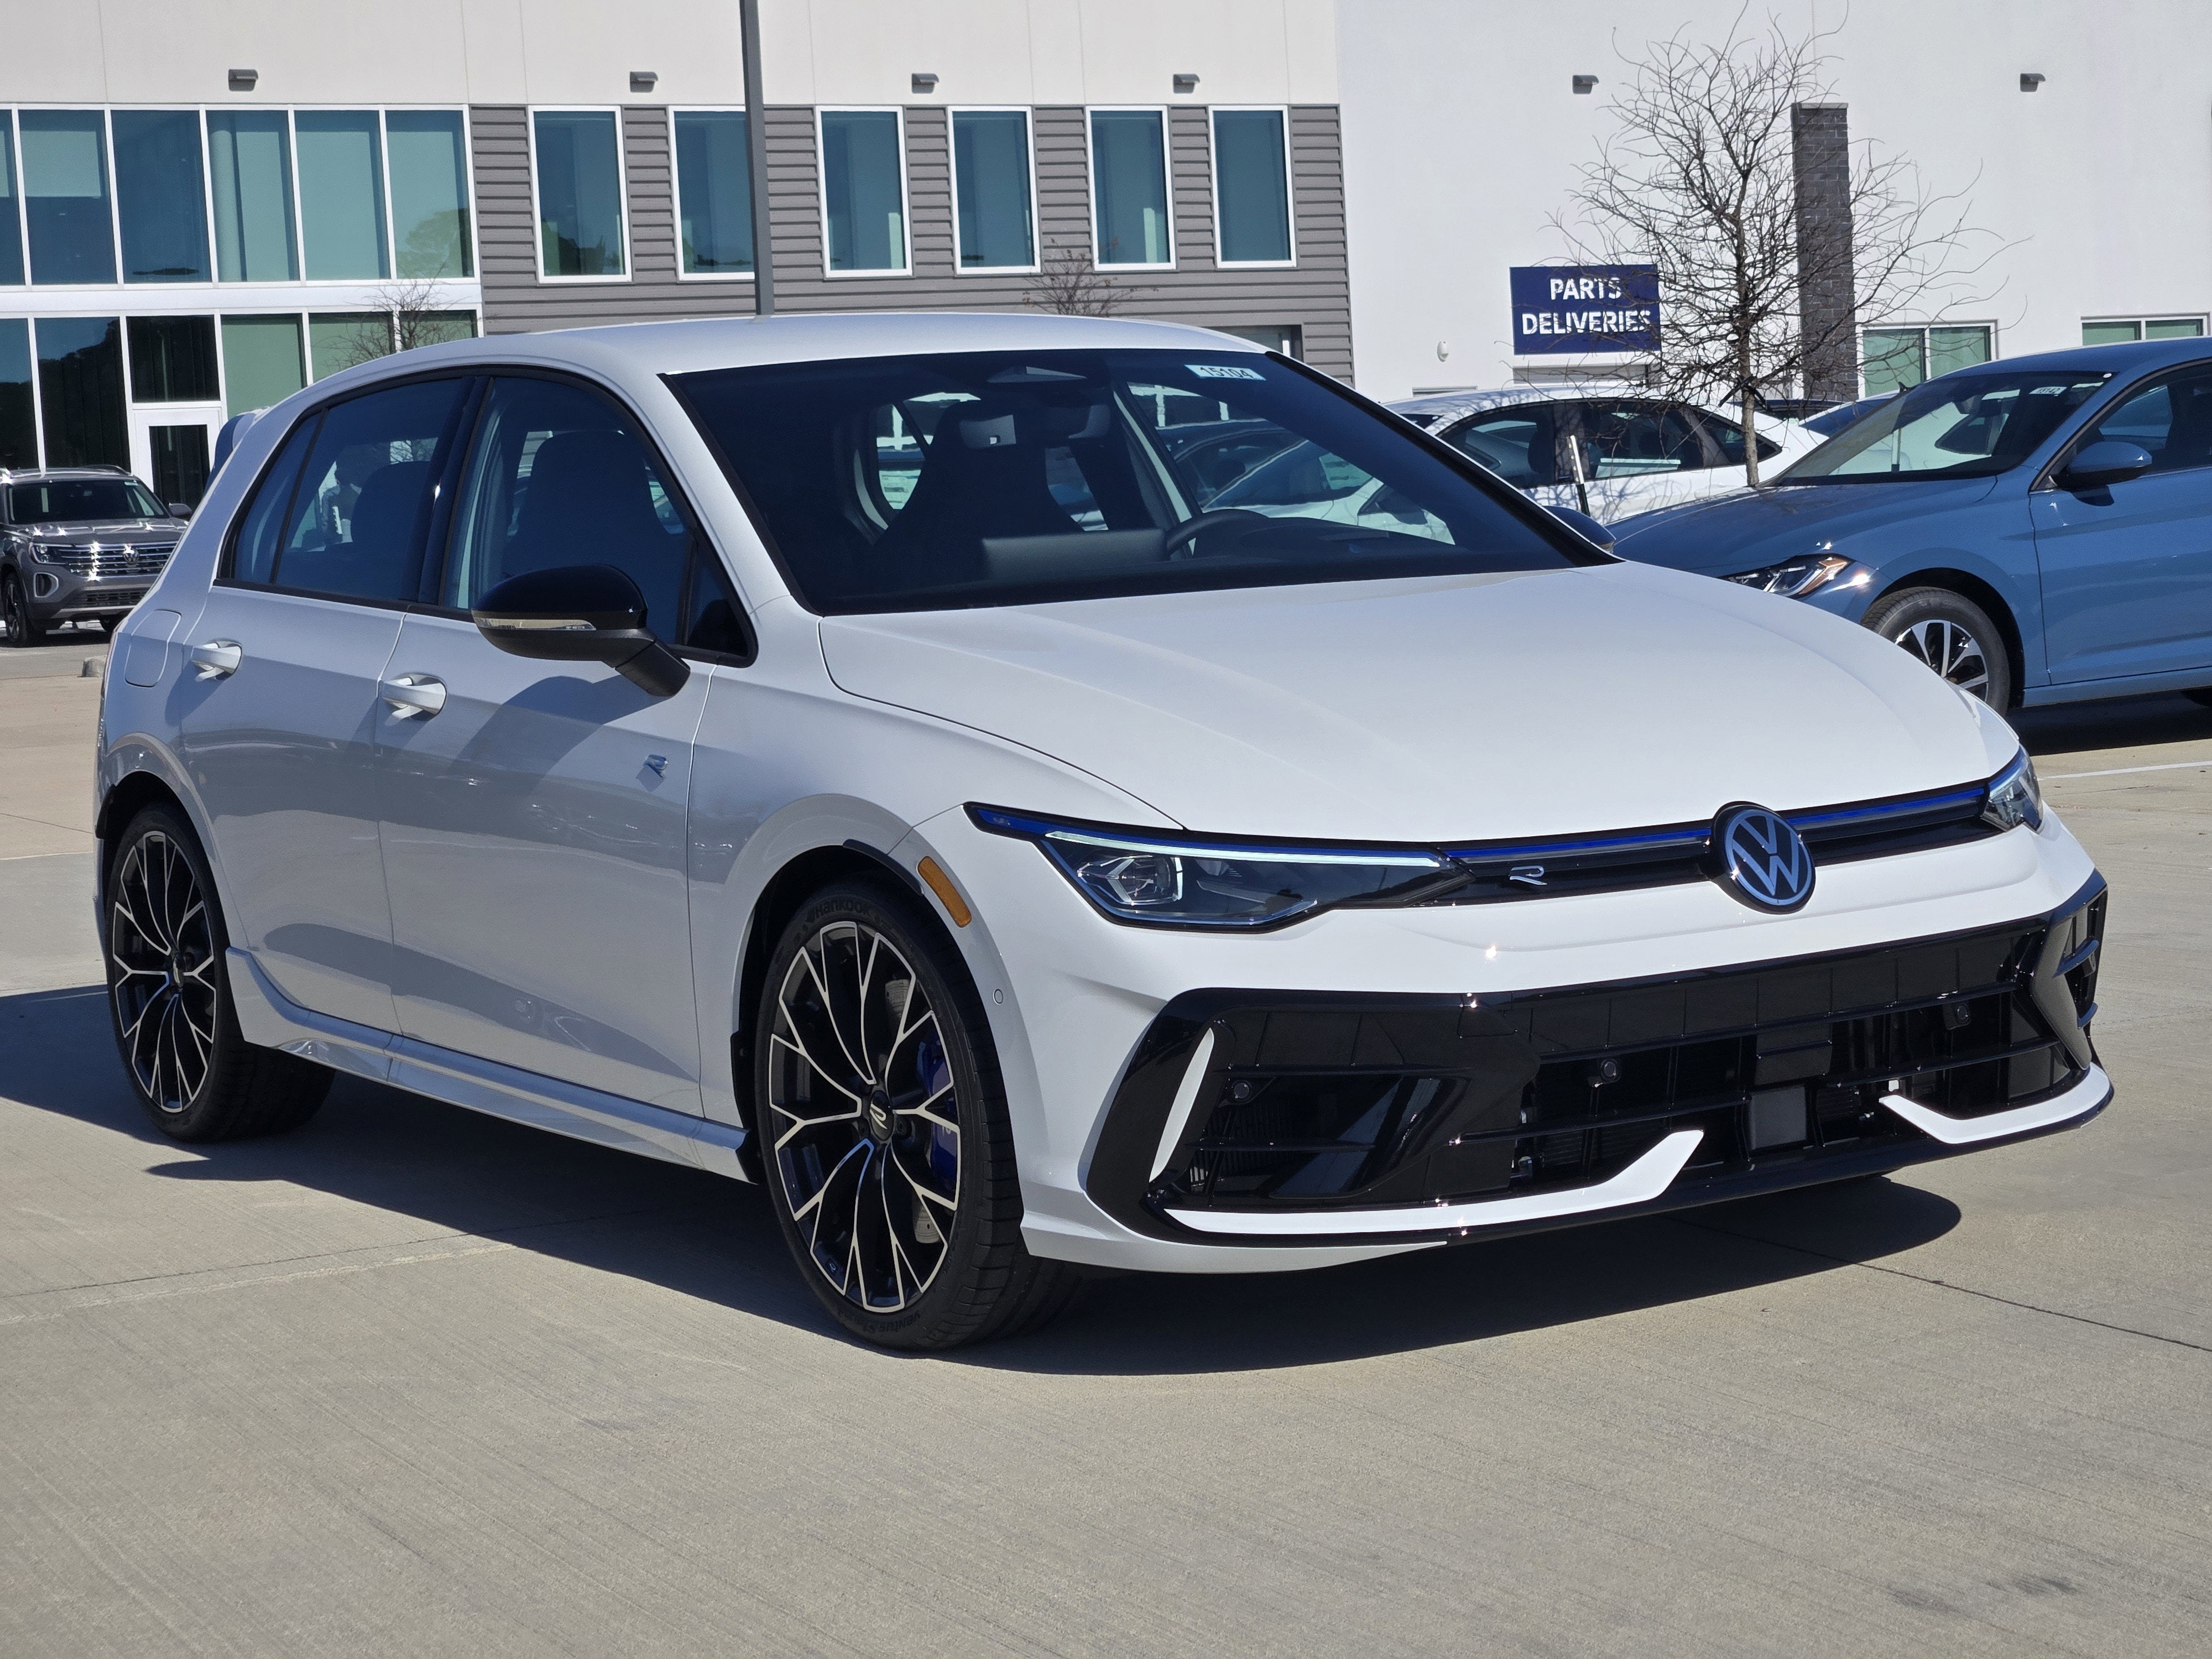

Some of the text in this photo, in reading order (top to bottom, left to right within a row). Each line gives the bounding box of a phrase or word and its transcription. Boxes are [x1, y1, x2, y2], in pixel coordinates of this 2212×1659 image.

[1550, 277, 1622, 300] PARTS
[1522, 310, 1651, 335] DELIVERIES
[1200, 367, 1254, 379] 15104
